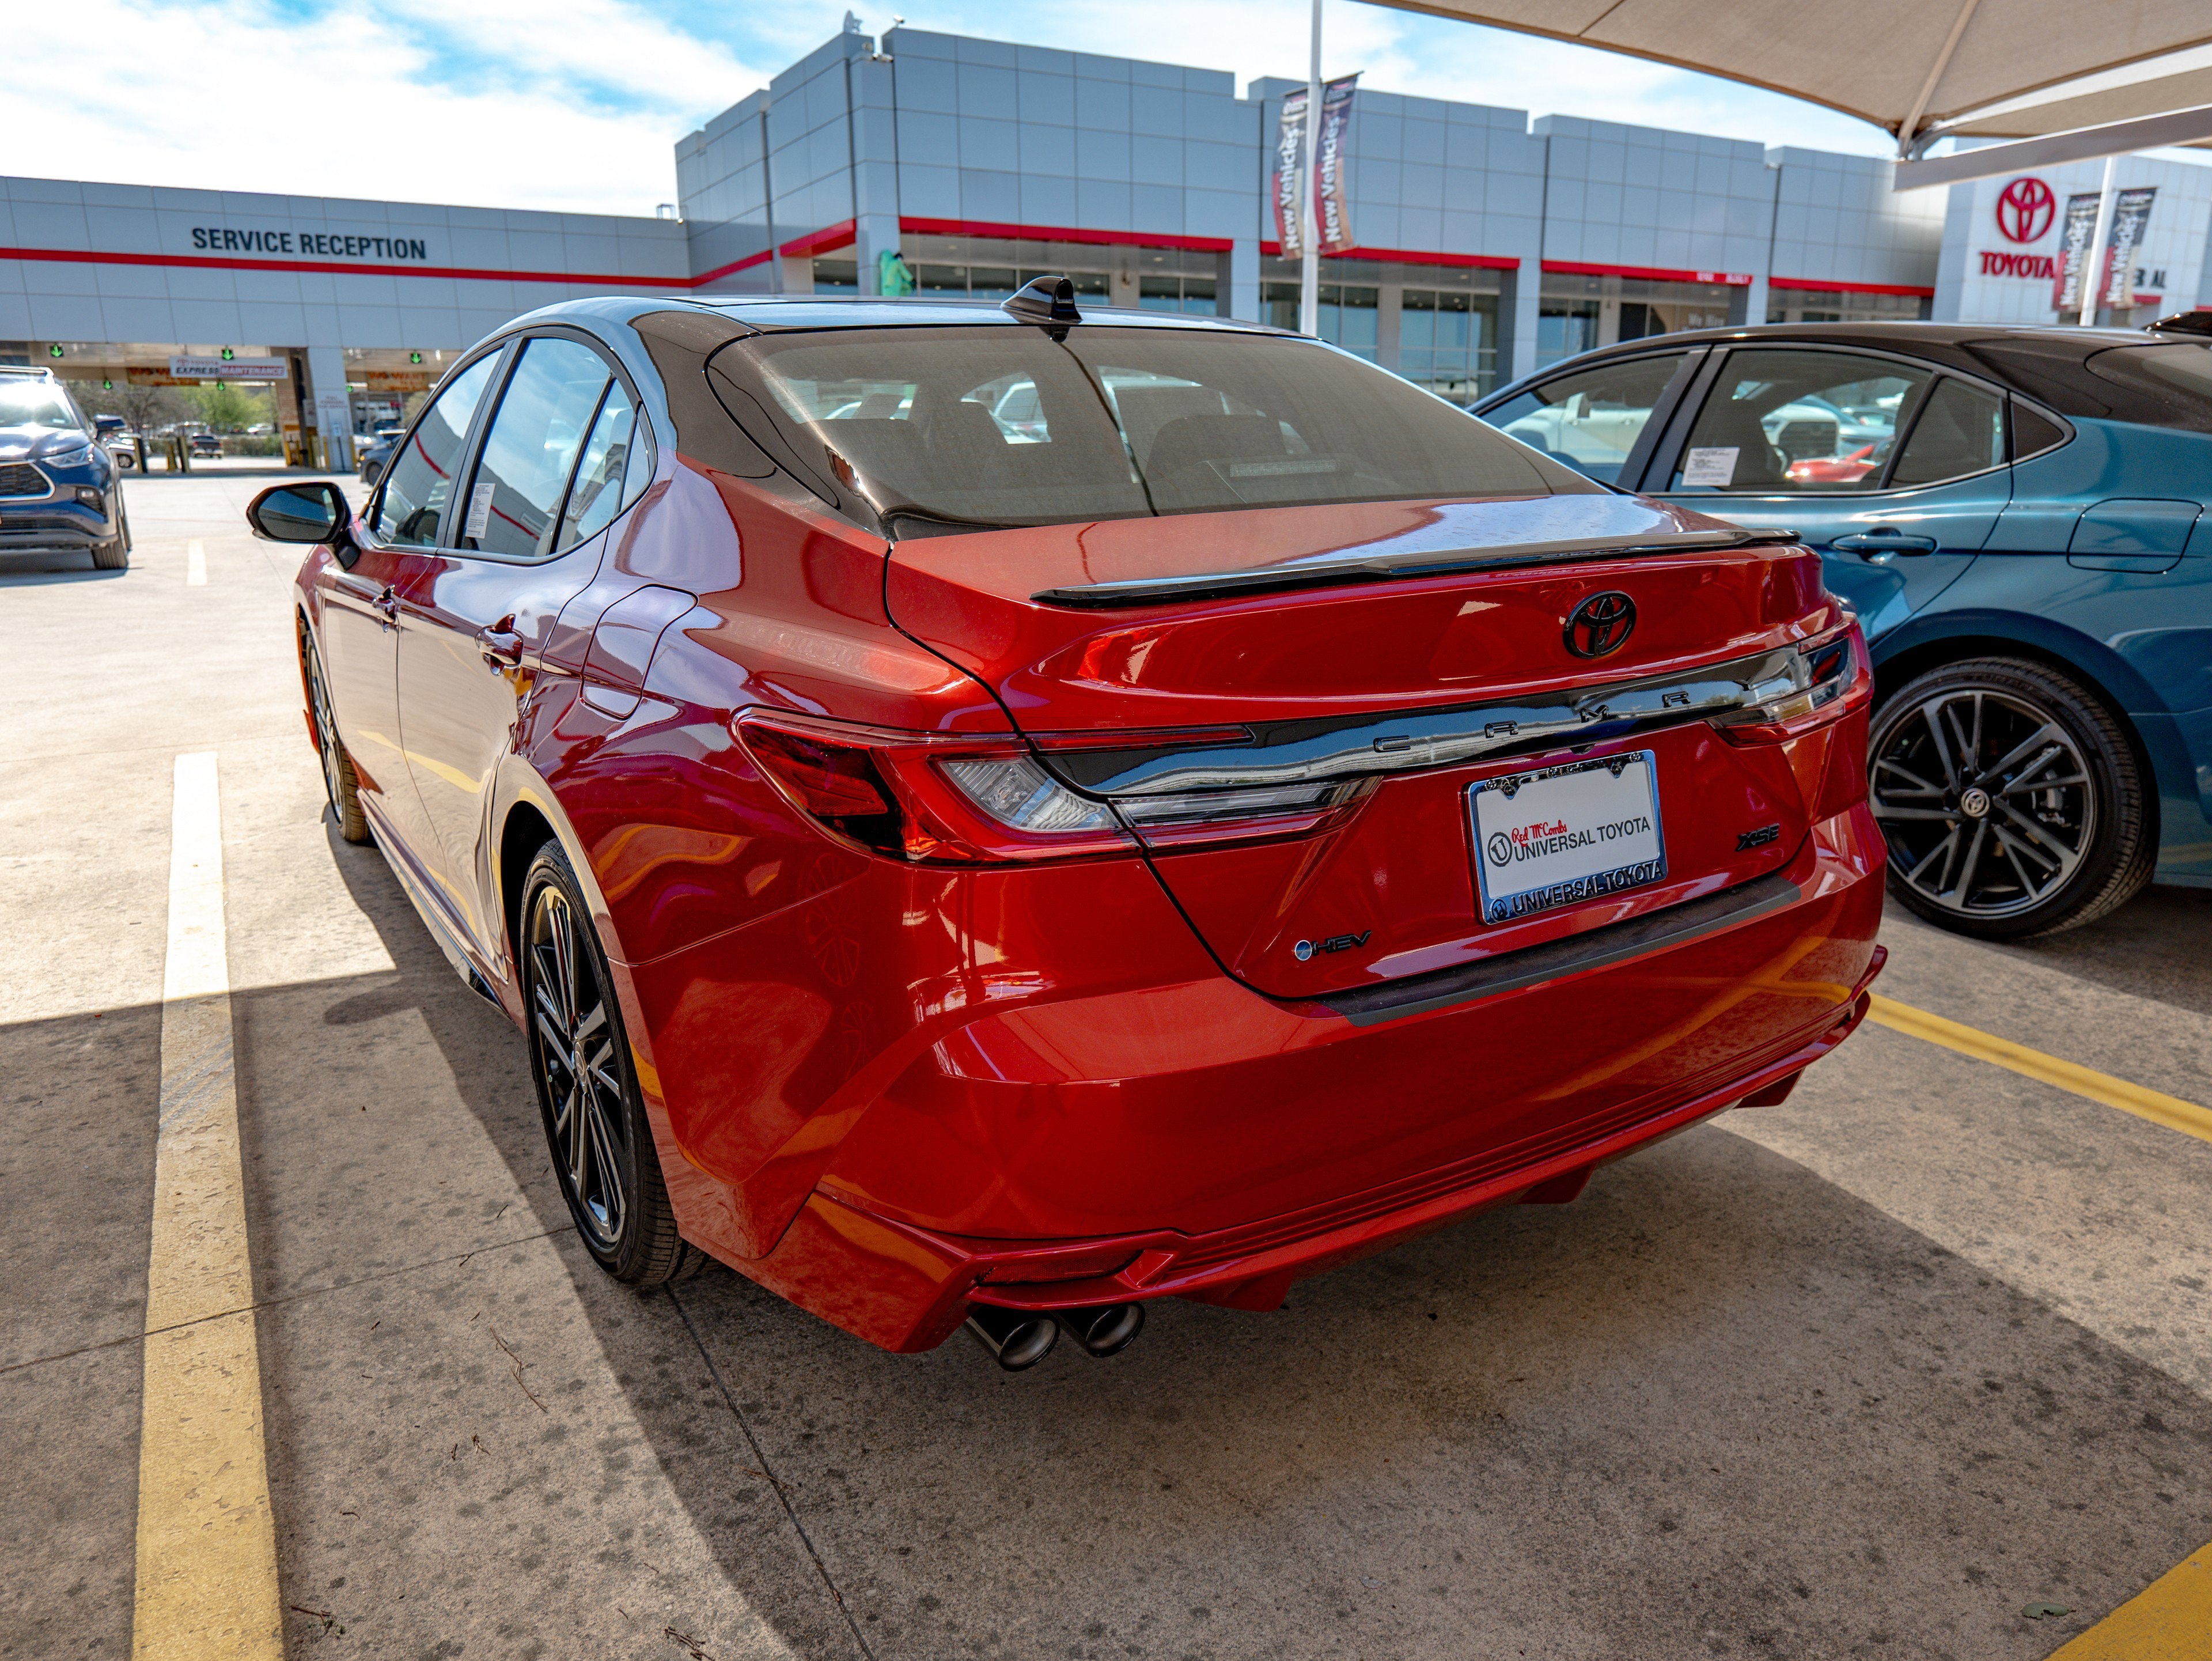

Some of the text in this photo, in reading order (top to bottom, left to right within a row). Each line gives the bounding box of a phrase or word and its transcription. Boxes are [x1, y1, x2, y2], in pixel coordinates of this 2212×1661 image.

[1279, 127, 1300, 207] Vehicles
[1320, 115, 1340, 199] Vehicles
[1282, 207, 1300, 250] New
[1324, 200, 1343, 243] New
[192, 228, 426, 259] SERVICE RECEPTION
[1979, 251, 2055, 279] TOYOTA
[176, 366, 219, 374] EXPRESS
[221, 366, 285, 376] MAINTENANCE
[1372, 676, 1755, 754] CAMRY
[1512, 819, 1567, 847] Red McCombs
[1514, 830, 1596, 862] UNIVERSAL
[1597, 816, 1651, 842] TOYOTA
[1735, 823, 1780, 852] XSE
[1510, 875, 1605, 915] UNIVERSAL
[1602, 861, 1663, 889] TOYOTA
[1312, 930, 1372, 956] HEV
